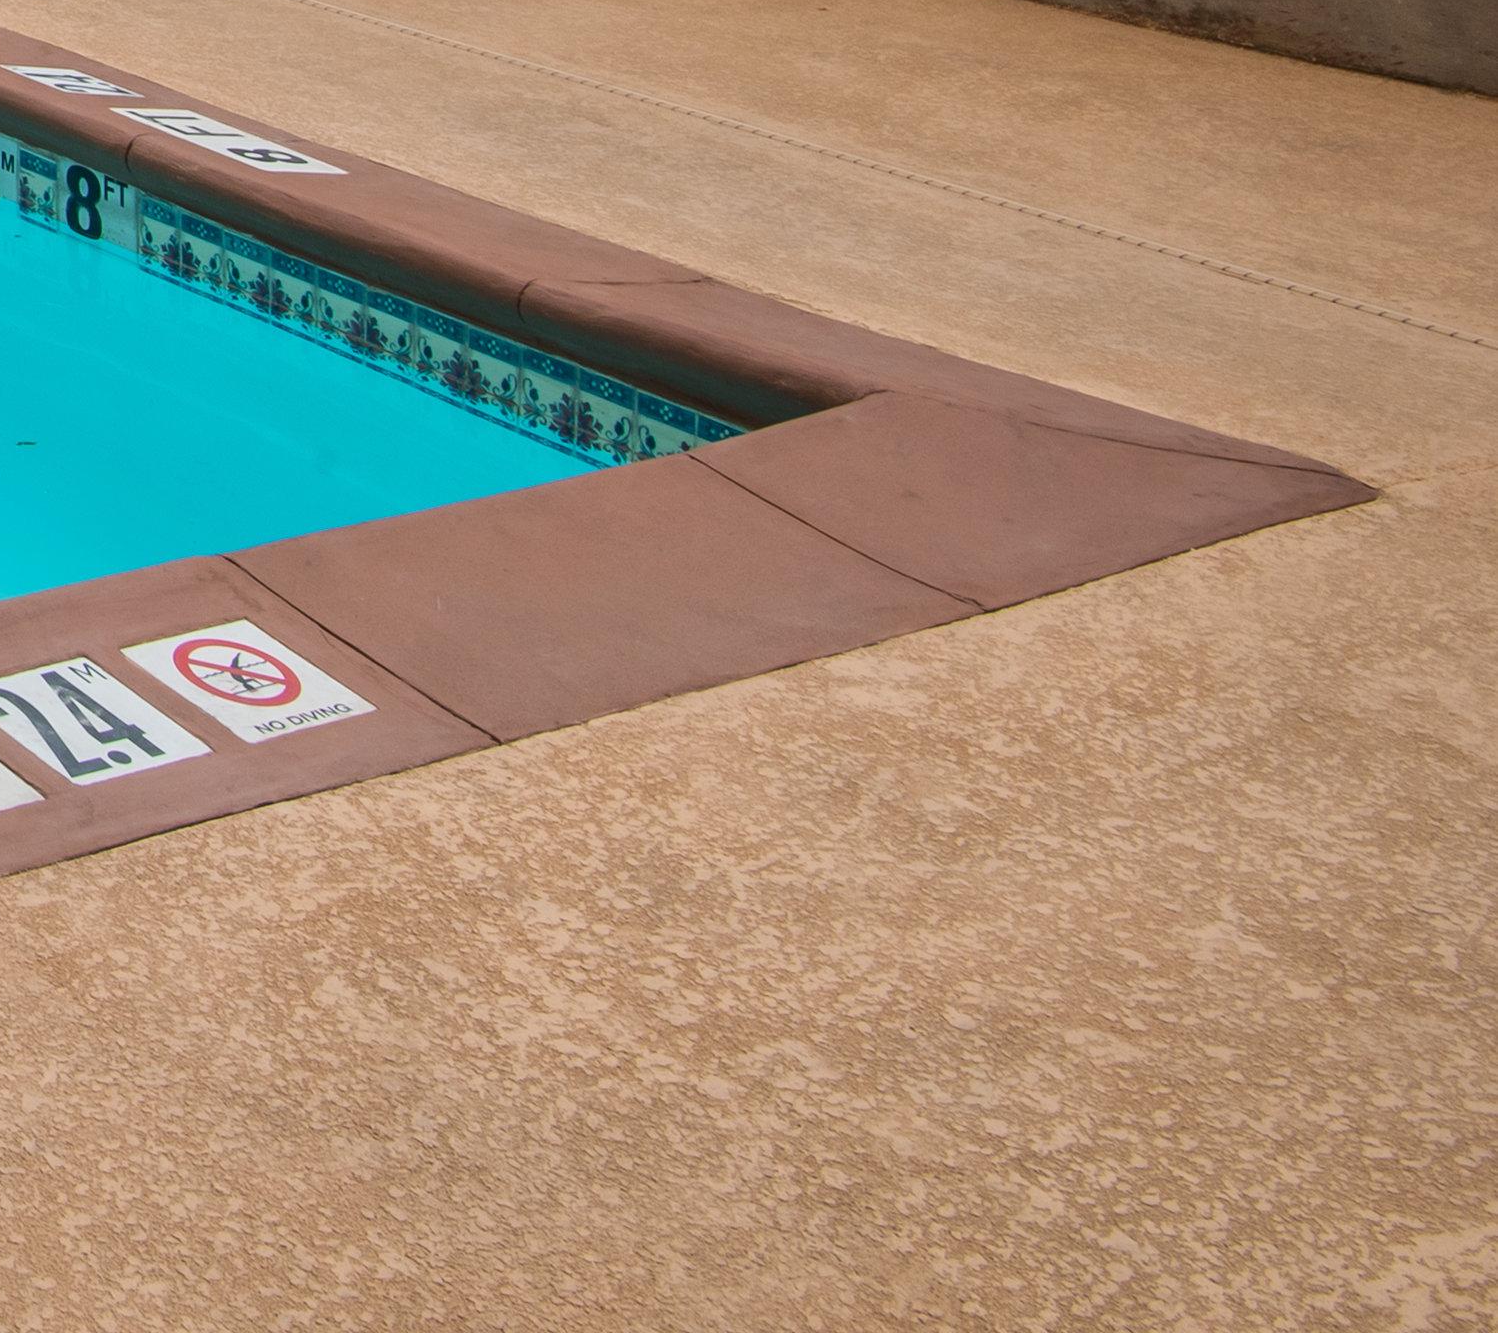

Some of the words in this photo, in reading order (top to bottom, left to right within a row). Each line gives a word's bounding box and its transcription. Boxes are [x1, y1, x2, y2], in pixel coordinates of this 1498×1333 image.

[128, 110, 246, 137] FT
[1, 151, 15, 174] M
[226, 147, 309, 164] 8
[66, 164, 102, 240] 8
[104, 175, 128, 208] FT
[254, 720, 286, 734] NO
[287, 703, 354, 726] DIVING
